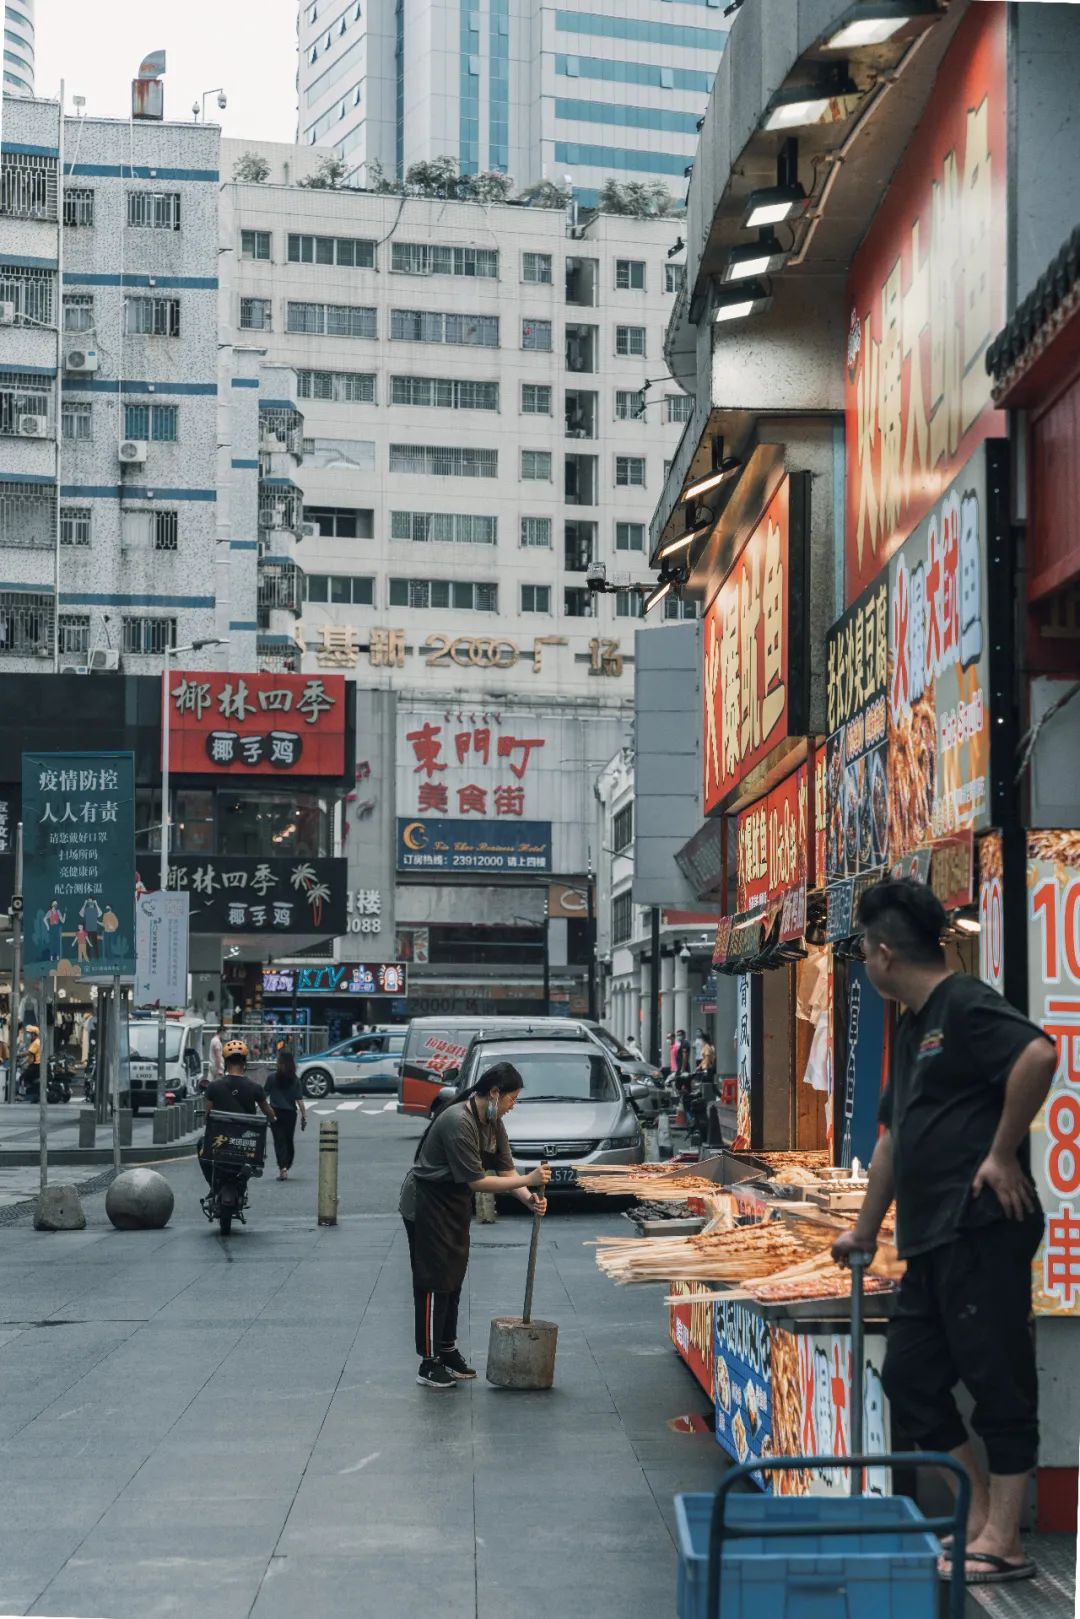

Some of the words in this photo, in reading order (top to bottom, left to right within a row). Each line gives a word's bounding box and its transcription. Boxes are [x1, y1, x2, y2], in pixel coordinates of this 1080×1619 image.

[857, 96, 993, 573] 火爆大鱿鱼
[891, 490, 984, 716] 火爆大鱿鱼
[827, 583, 888, 734] 老长沙臭豆腐
[171, 679, 336, 723] 椰林四季
[211, 731, 299, 763] 椰子鸡
[406, 722, 545, 780] 東門町
[39, 770, 119, 792] 疫情防控
[418, 782, 525, 816] 美食街
[39, 801, 118, 823] 人人有责
[50, 832, 108, 844] 请您戴好口罩
[59, 850, 98, 861] 扫场所码
[453, 856, 503, 866] 23912000
[59, 866, 98, 878] 亮健康码
[160, 864, 279, 896] 椰林四季
[54, 883, 103, 895] 配合测体温
[228, 902, 294, 926] 椰子鸡
[298, 966, 346, 989] KTV
